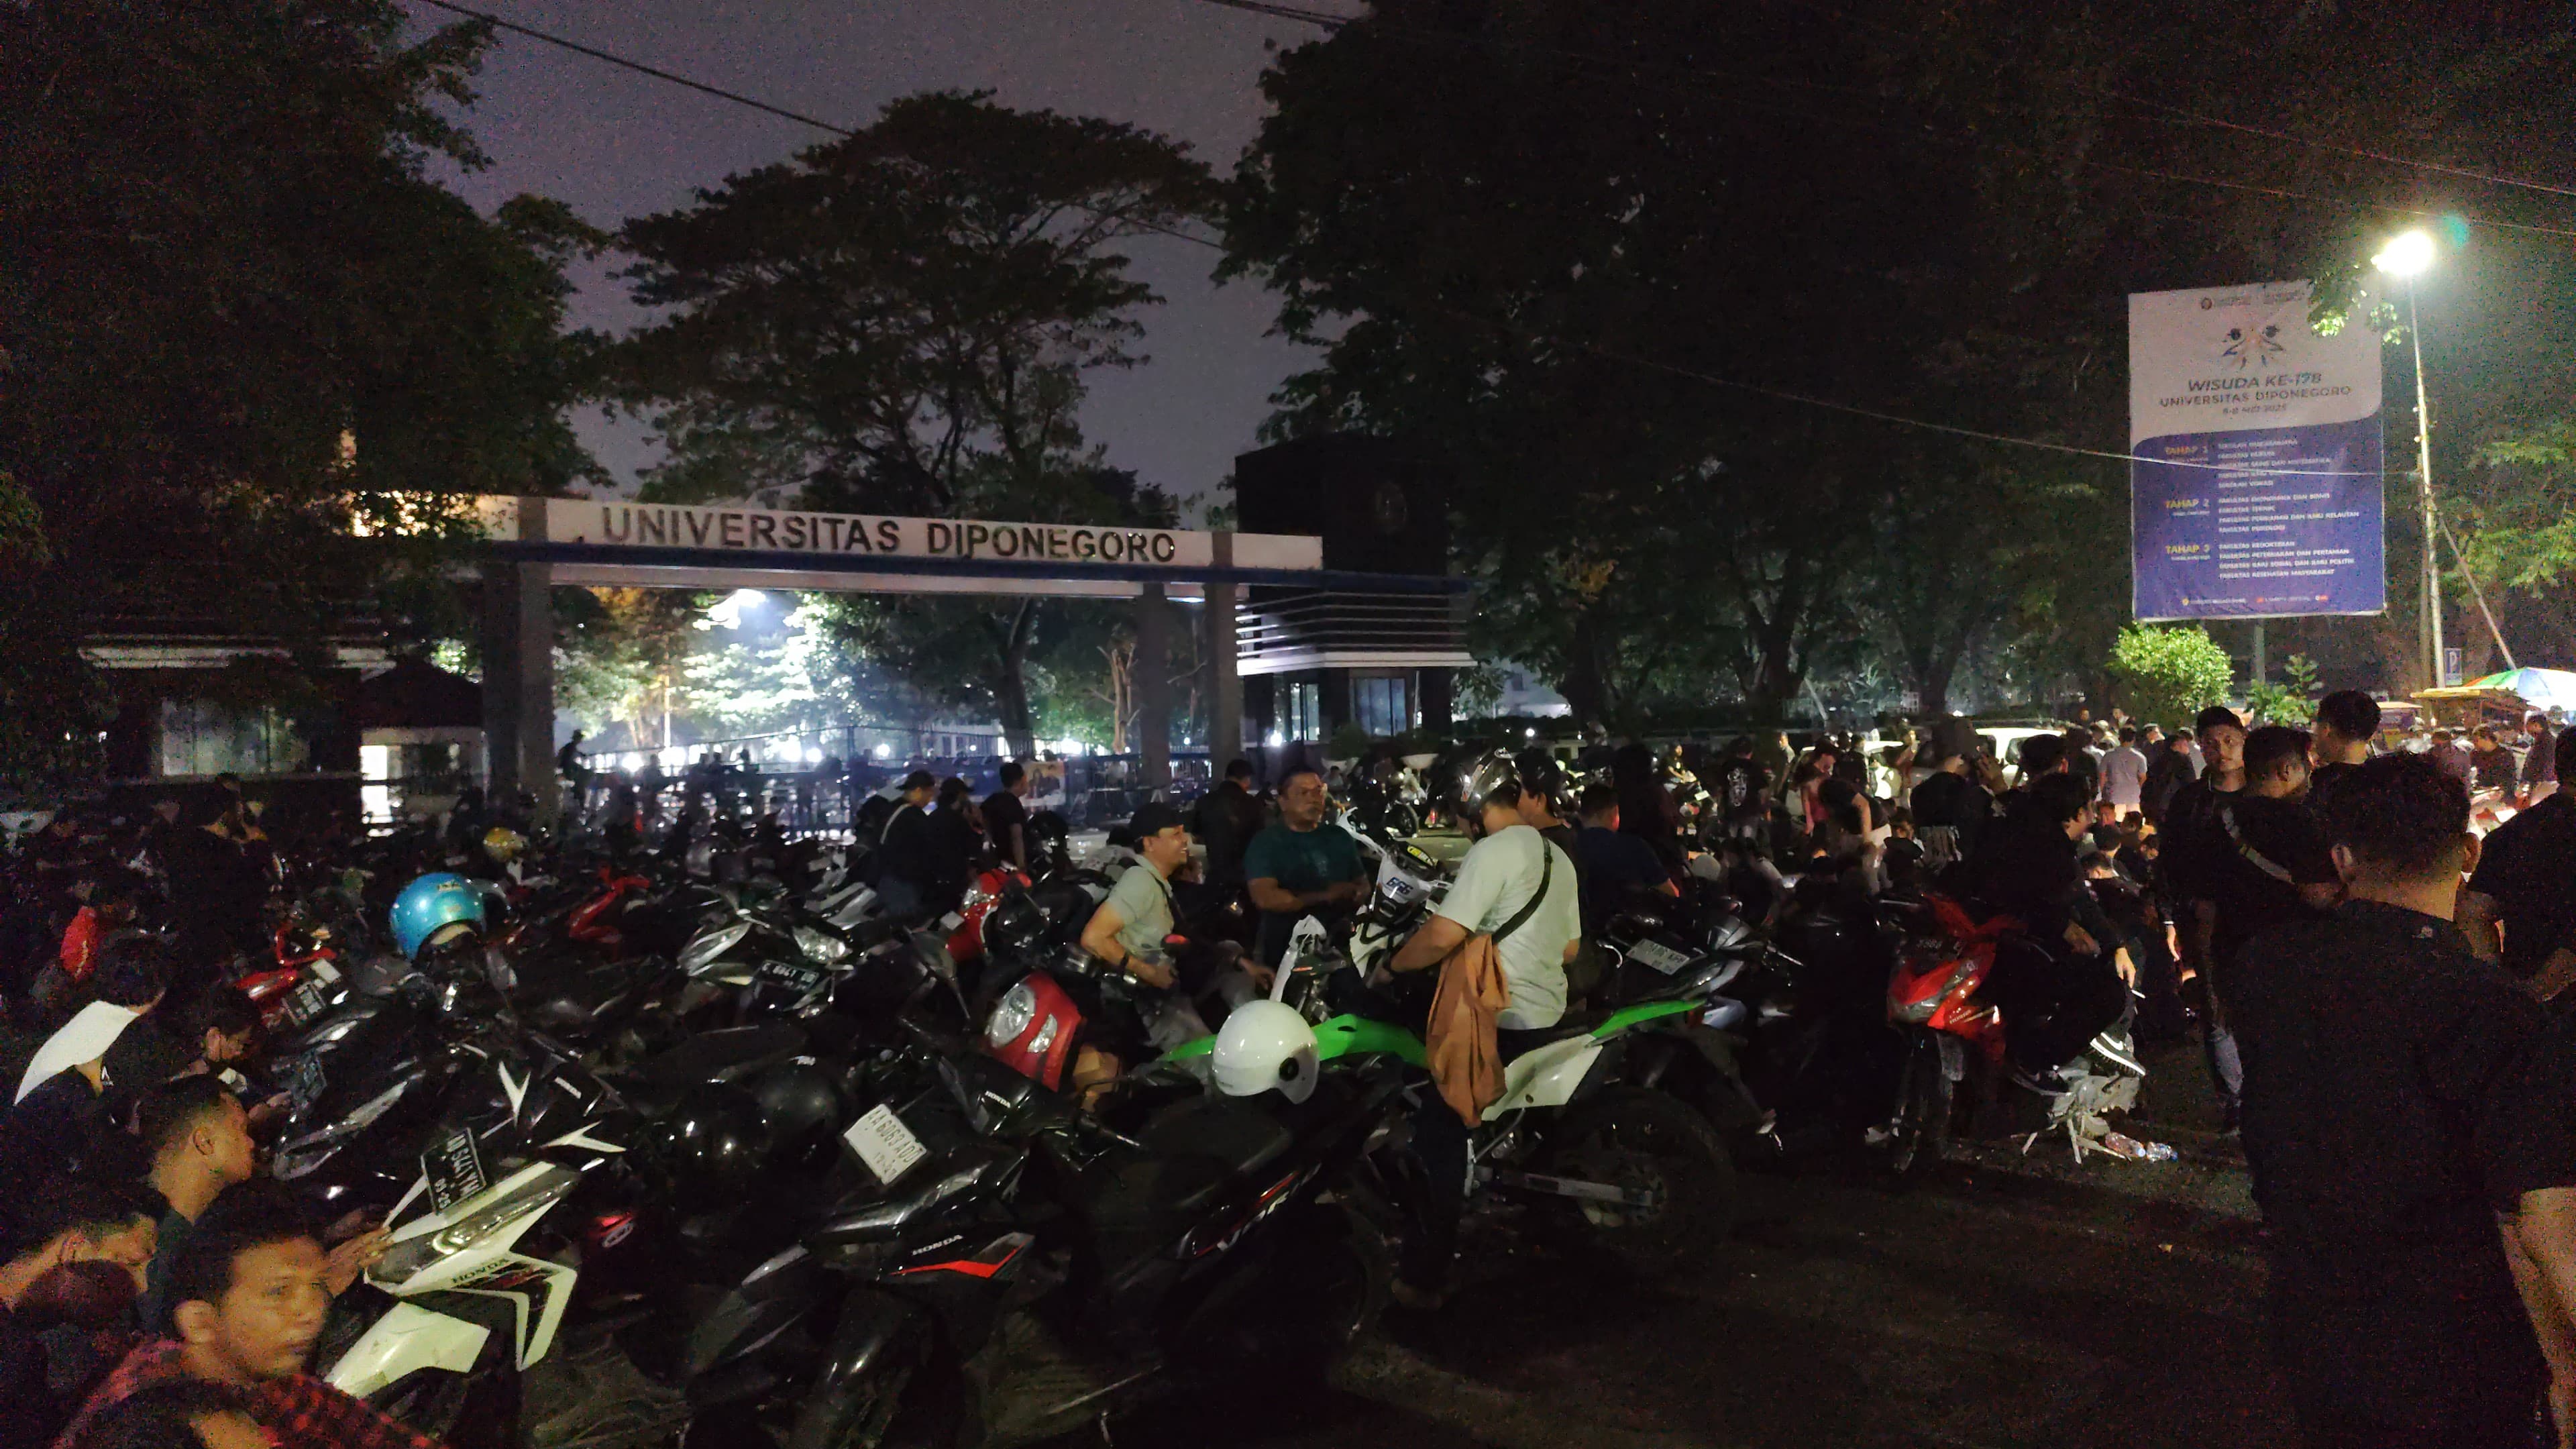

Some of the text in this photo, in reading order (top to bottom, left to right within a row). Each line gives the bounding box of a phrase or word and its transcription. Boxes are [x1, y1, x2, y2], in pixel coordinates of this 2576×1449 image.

[2188, 377, 2259, 392] WISUDA
[2159, 386, 2353, 407] UNIVERSITAS DIPONEGORO
[2165, 498, 2209, 508] TAHAP 2
[602, 506, 1175, 563] UNIVERSITAS DIPONEGORO
[2165, 544, 2210, 553] TAHAP 3
[912, 1234, 963, 1254] HONDA
